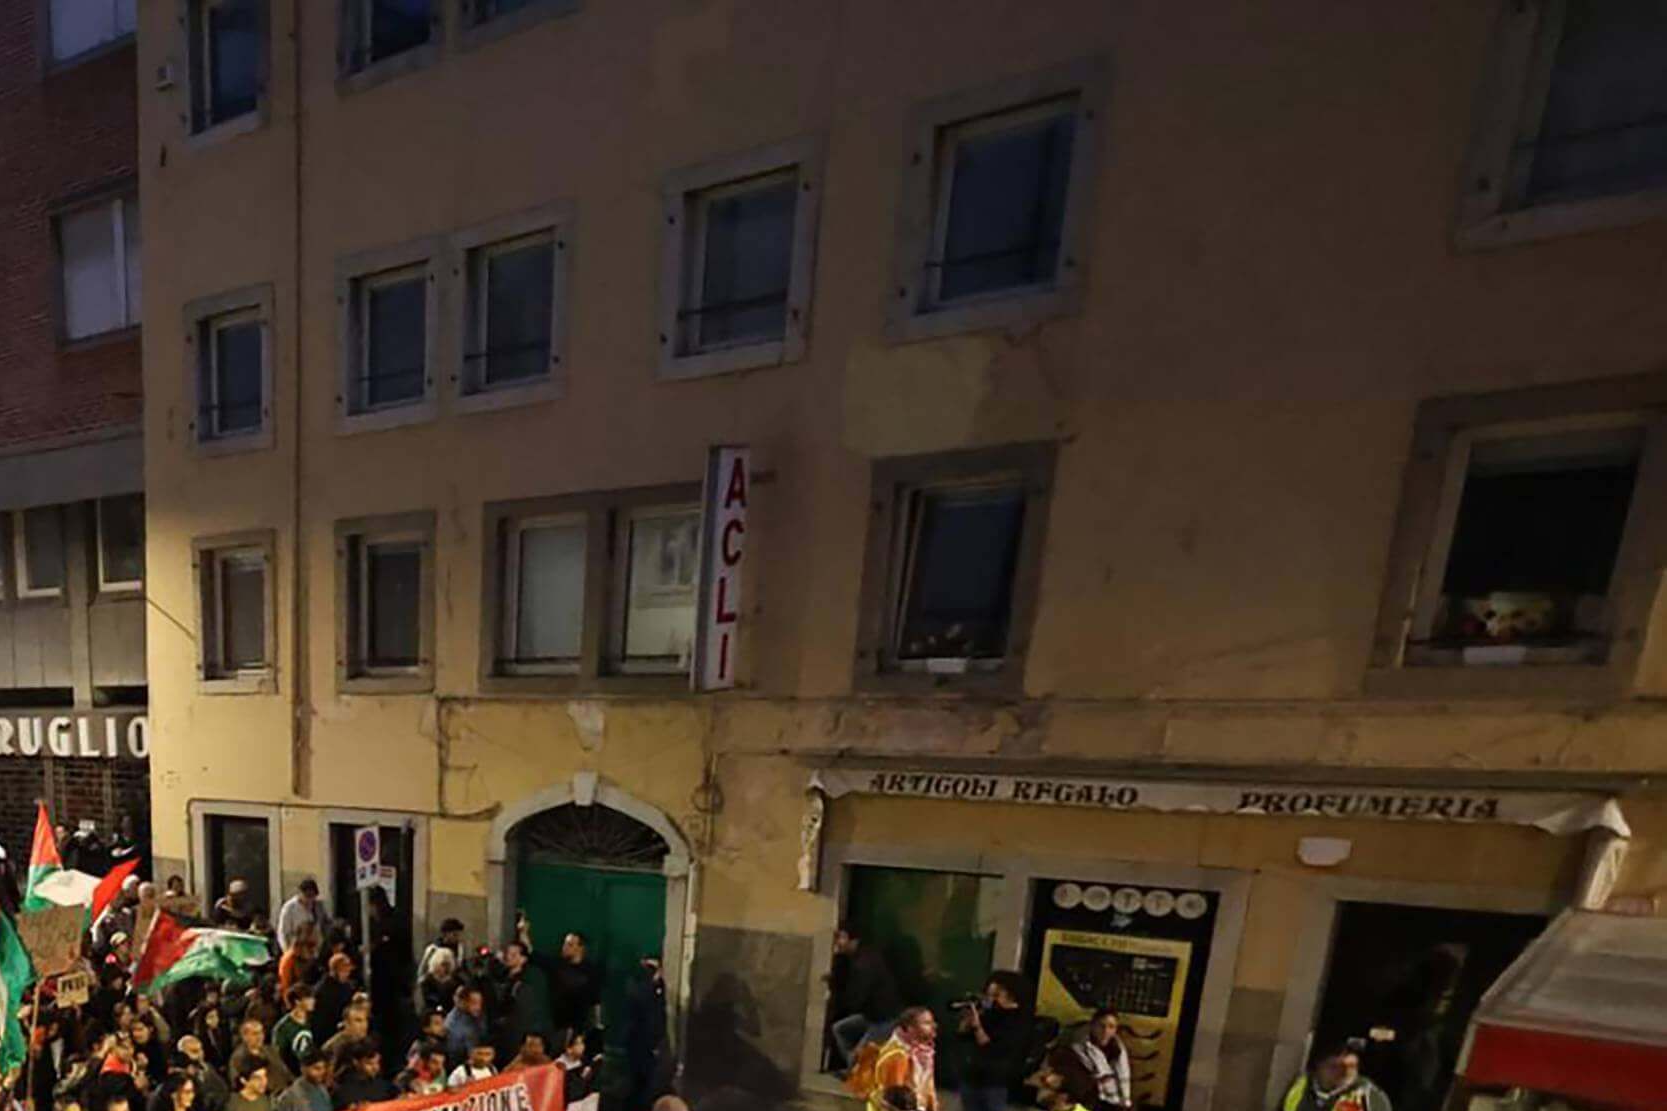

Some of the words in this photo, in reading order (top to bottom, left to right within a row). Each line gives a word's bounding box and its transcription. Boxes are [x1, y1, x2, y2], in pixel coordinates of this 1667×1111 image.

[716, 457, 747, 681] ACLI
[1012, 779, 1139, 807] REGALO
[1236, 790, 1501, 818] PROFUMERIA
